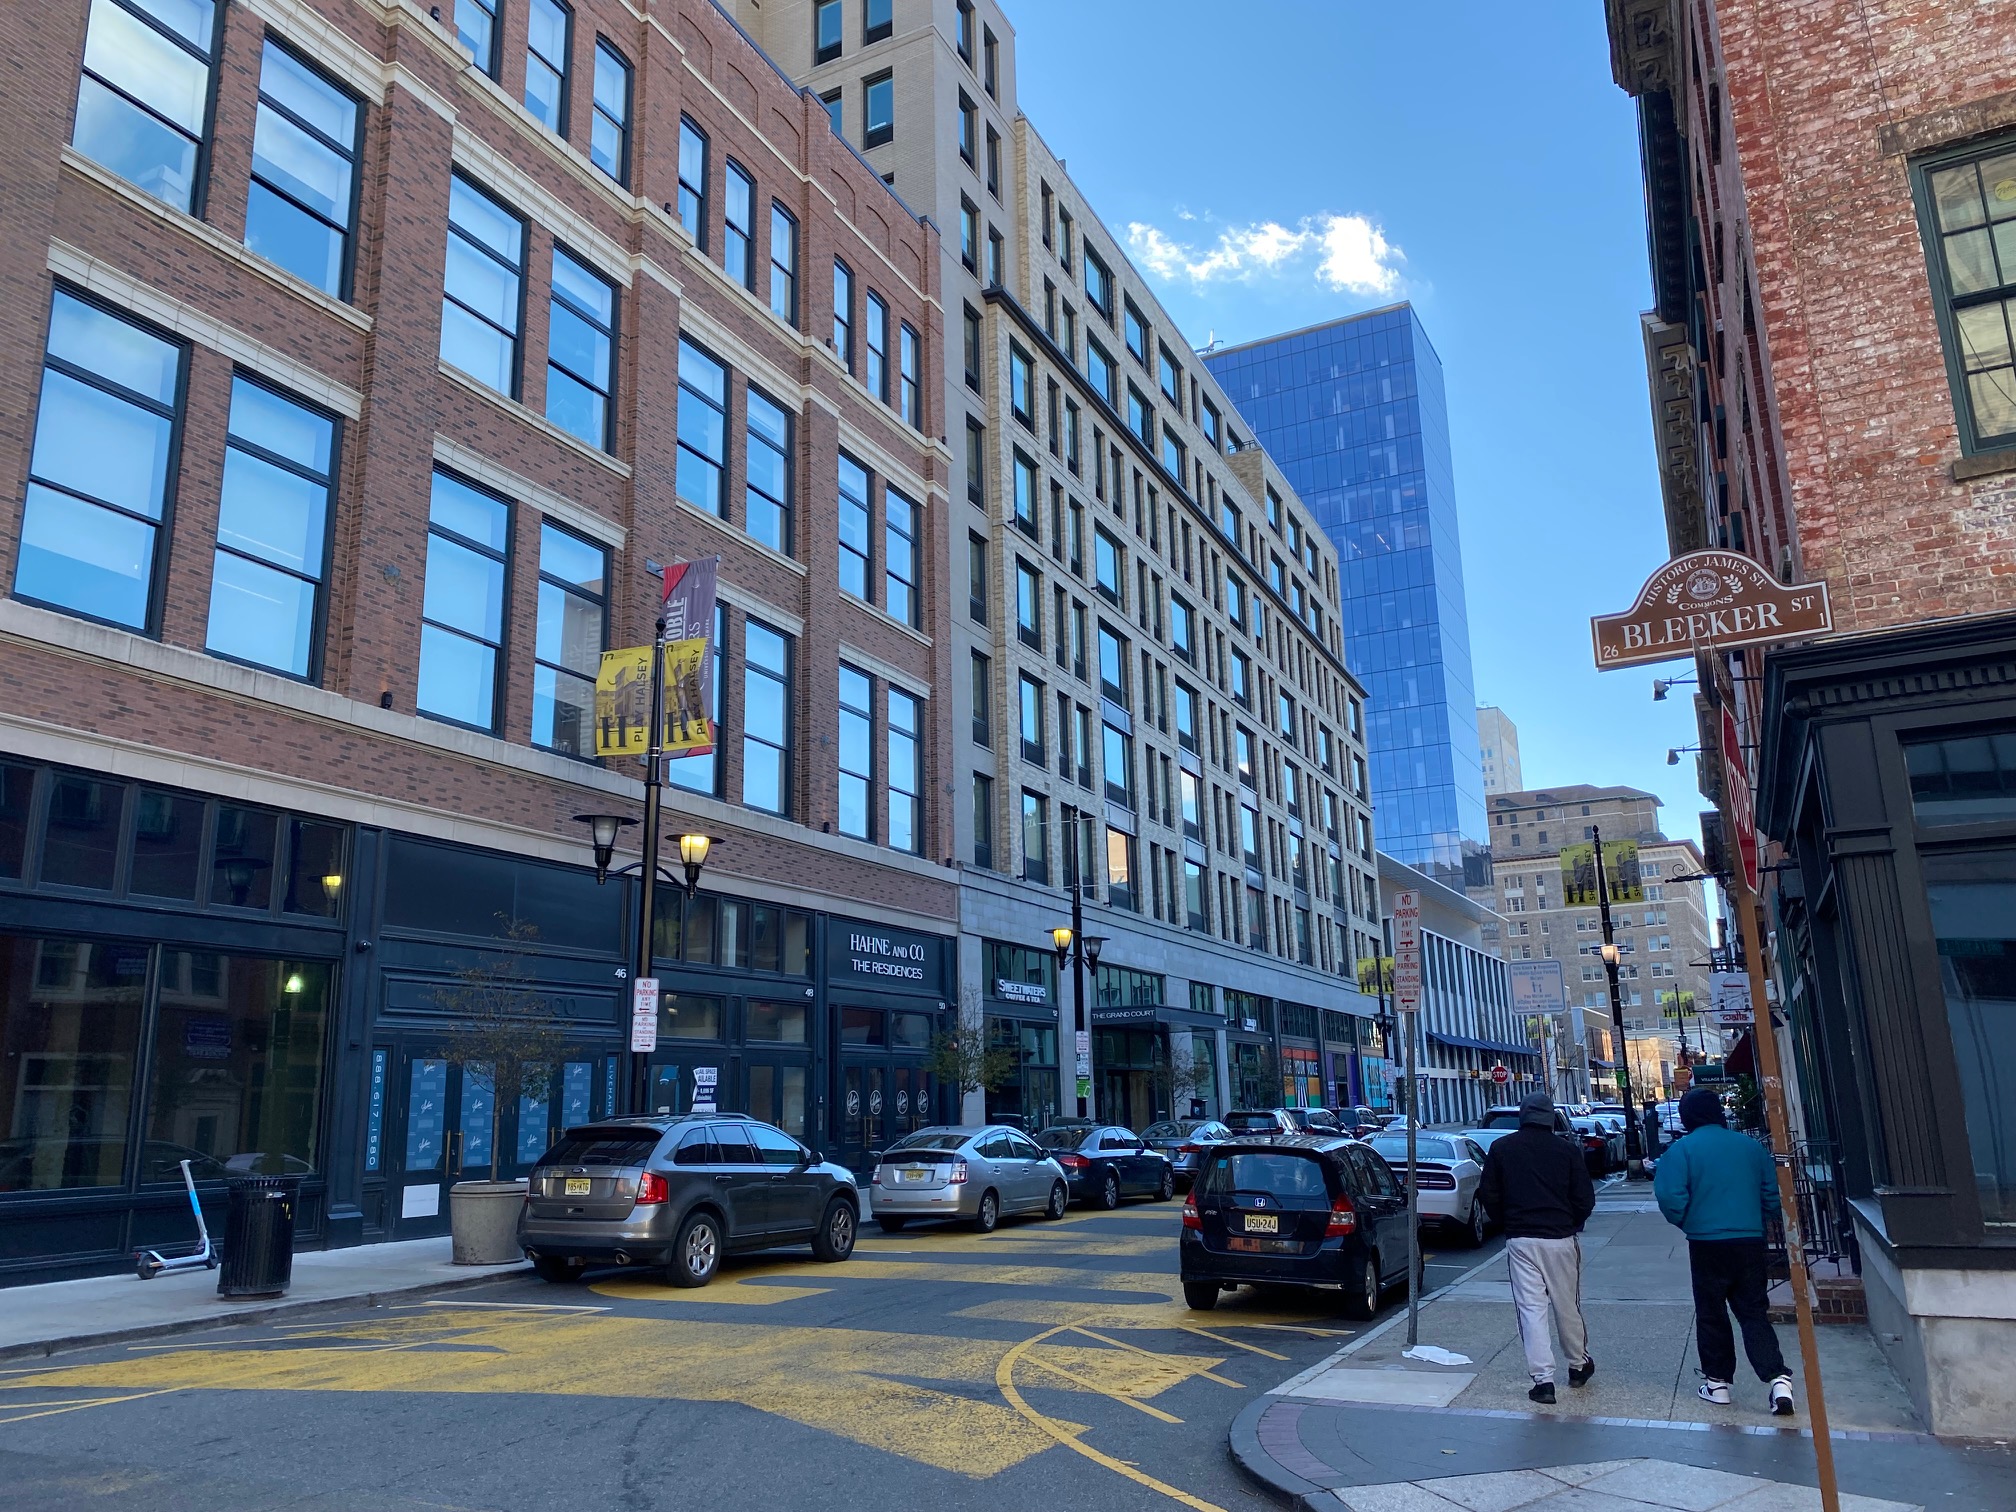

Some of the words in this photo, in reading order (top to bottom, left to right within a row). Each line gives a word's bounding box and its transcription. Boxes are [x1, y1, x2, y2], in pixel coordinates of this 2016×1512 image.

[1644, 558, 1699, 607] HISTORIC
[1703, 556, 1749, 575] JAMES
[1749, 572, 1768, 590] ST.
[1678, 595, 1734, 611] COMMONS
[1621, 602, 1784, 650] BLEEKER
[1791, 595, 1815, 612] ST
[1819, 612, 1826, 626] 1
[1603, 645, 1619, 659] 26
[689, 649, 701, 698] HALSEY
[635, 657, 648, 706] HALSEY
[634, 710, 644, 742] PLAY
[1584, 849, 1594, 877] HALSEY
[1628, 845, 1639, 874] HALSEY
[1401, 895, 1412, 906] NO
[1395, 907, 1418, 919] PARKING
[1401, 920, 1412, 928] ANY
[1401, 930, 1413, 938] TIME
[850, 933, 890, 956] HAHNE
[892, 945, 908, 959] AND
[909, 944, 925, 962] CO.
[1403, 954, 1411, 963] NO
[851, 959, 871, 973] THE
[872, 961, 923, 980] RESIDENCES
[1396, 962, 1419, 970] PARKING
[614, 968, 627, 979] 46
[1396, 974, 1419, 983] STANDING
[804, 988, 814, 997] 48
[1106, 1011, 1130, 1019] GRAND
[1131, 1009, 1155, 1017] COURT
[1493, 1071, 1507, 1079] STOP
